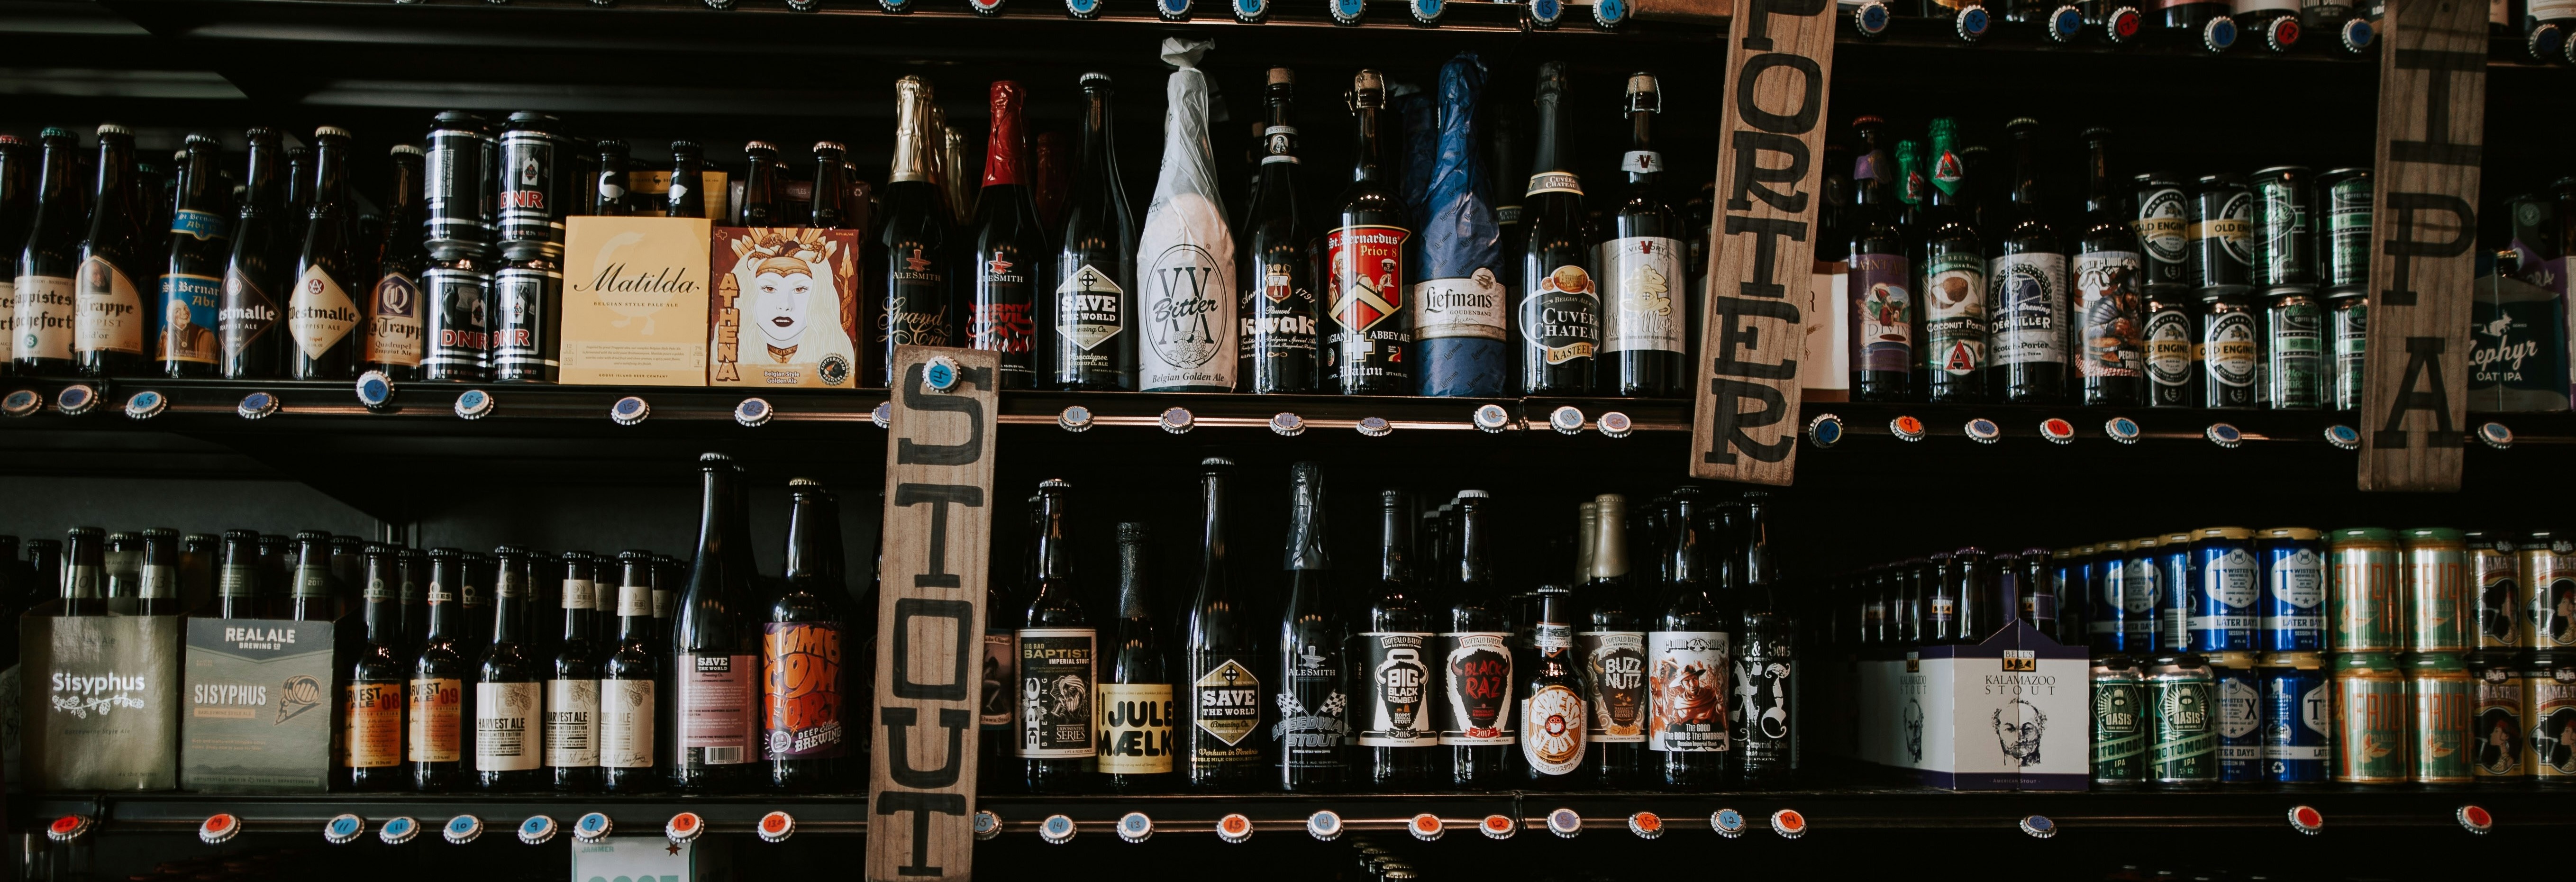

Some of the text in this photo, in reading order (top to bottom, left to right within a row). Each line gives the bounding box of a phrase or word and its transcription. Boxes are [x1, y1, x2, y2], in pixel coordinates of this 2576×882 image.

[1605, 2, 1617, 16] 14
[1869, 13, 1884, 23] 32
[2064, 18, 2077, 29] 16
[501, 190, 544, 209] DNR
[1705, 0, 1826, 464] PORTER
[2215, 224, 2235, 232] OLD
[1361, 245, 1388, 257] Prior
[2373, 49, 2488, 448] IPA
[573, 263, 700, 293] Matilda
[1295, 288, 1315, 303] 1791
[1425, 286, 1493, 313] Liefmans
[1061, 295, 1116, 312] SAVE
[1153, 297, 1218, 322] Bitter
[289, 300, 355, 322] Westmalle
[1081, 313, 1116, 321] WORLD
[1542, 308, 1595, 325] CUVÉE
[716, 273, 740, 381] ATHENA
[1531, 322, 1599, 340] CHATEAU
[1927, 321, 1963, 333] COCONUT
[441, 329, 490, 351] DNR
[493, 329, 530, 346] DNR
[1370, 330, 1411, 343] ABBEY ALE
[1553, 345, 1591, 361] KASTEEL
[2158, 345, 2188, 353] ENGINE
[2468, 334, 2539, 372] Zephyr
[820, 357, 846, 371] COPPERHEAD
[1153, 374, 1179, 383] Belgian
[1183, 373, 1211, 381] Golden
[2476, 372, 2522, 382] OAT IPA
[137, 394, 156, 407] 6.5
[1071, 410, 1080, 419] 11
[1904, 419, 1913, 430] 9
[2120, 424, 2133, 435] 10
[876, 362, 992, 876] STOUT
[225, 627, 295, 644] REAL ALE
[1384, 636, 1406, 646] BUFFALO
[1464, 637, 1485, 646] BUFFALO
[764, 625, 841, 668] NUMB
[1665, 639, 1725, 653] CLOWN SHOES
[1752, 641, 1790, 660] & Sons
[1024, 649, 1089, 659] BAPTIST
[698, 657, 728, 666] SAVE
[1605, 657, 1641, 673] BUZZ
[1465, 660, 1502, 677] BLACK
[53, 672, 145, 695] Sisyphus
[1388, 668, 1418, 687] BIG
[1605, 673, 1641, 690] NUTZ
[1900, 675, 1926, 685] KALAMAZOO
[1985, 675, 2056, 685] KALAMAZOO
[1388, 688, 1418, 696] BLACK
[1465, 676, 1501, 699] RAZ
[1900, 685, 1926, 695] STOUT
[1985, 685, 2056, 696] STOUT
[194, 684, 266, 706] SISYPHUS
[382, 693, 400, 710] 08
[414, 695, 434, 703] ALE
[440, 688, 458, 704] 09
[1202, 690, 1255, 706] SAVE
[1388, 696, 1418, 704] COWBELL
[351, 700, 375, 709] ALE
[1531, 690, 1581, 730] ESPRESSO
[547, 711, 587, 722] HARVEST ALE
[1108, 700, 1172, 727] JULE
[2106, 713, 2132, 725] OASIS
[2173, 712, 2200, 724] OASIS
[478, 718, 525, 729] HARVEST ALE
[1210, 721, 1240, 729] Brewing
[1272, 716, 1351, 742] SPEEDWAY
[1686, 724, 1711, 732] The GOOD
[795, 726, 841, 753] BREWING
[798, 728, 819, 739] DEEP
[1056, 730, 1085, 740] SERIES
[1692, 732, 1701, 740] The
[1098, 731, 1172, 756] MÆLK
[1287, 734, 1339, 747] STOUT
[1530, 728, 1575, 755] STOUT
[2237, 748, 2255, 757] DAYS
[2184, 758, 2195, 766] IPA
[530, 822, 538, 831] 9
[589, 818, 596, 829] 9
[975, 817, 989, 827] 15
[1053, 821, 1064, 829] 14
[1492, 820, 1504, 828] 12
[1723, 816, 1735, 825] 12
